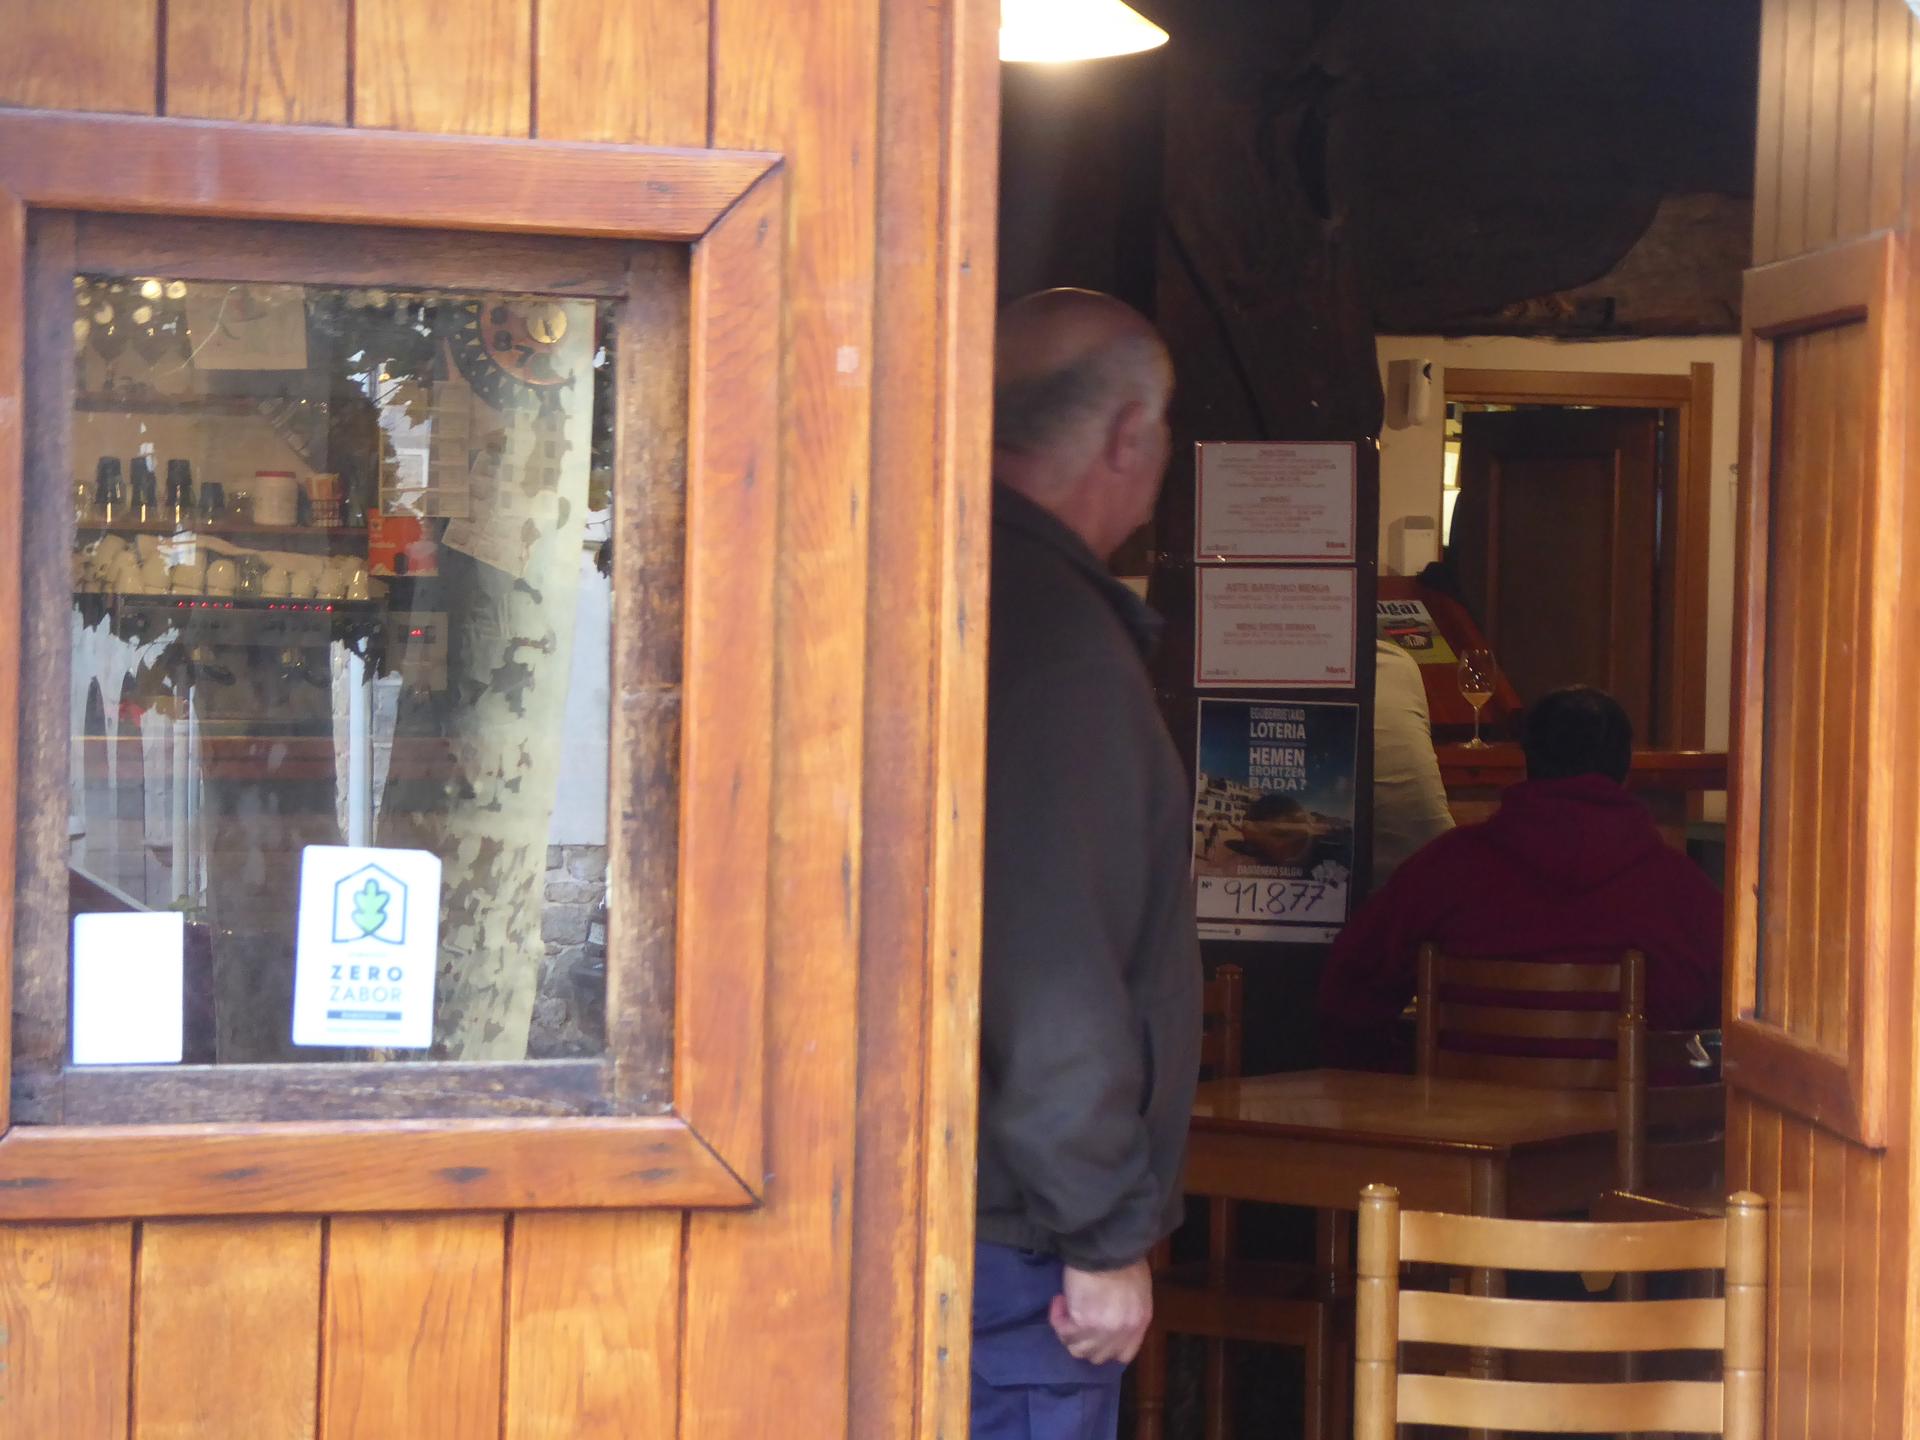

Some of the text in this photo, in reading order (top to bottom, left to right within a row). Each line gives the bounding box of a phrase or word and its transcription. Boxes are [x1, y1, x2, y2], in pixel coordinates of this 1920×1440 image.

[1249, 722, 1307, 739] LOTERIA
[1249, 747, 1305, 766] HEMEN
[1249, 766, 1306, 778] ERORTZEN
[1249, 777, 1306, 791] BADA?
[1223, 880, 1326, 914] 91.877
[331, 965, 402, 982] ZERO
[329, 985, 402, 1002] ZABOR
